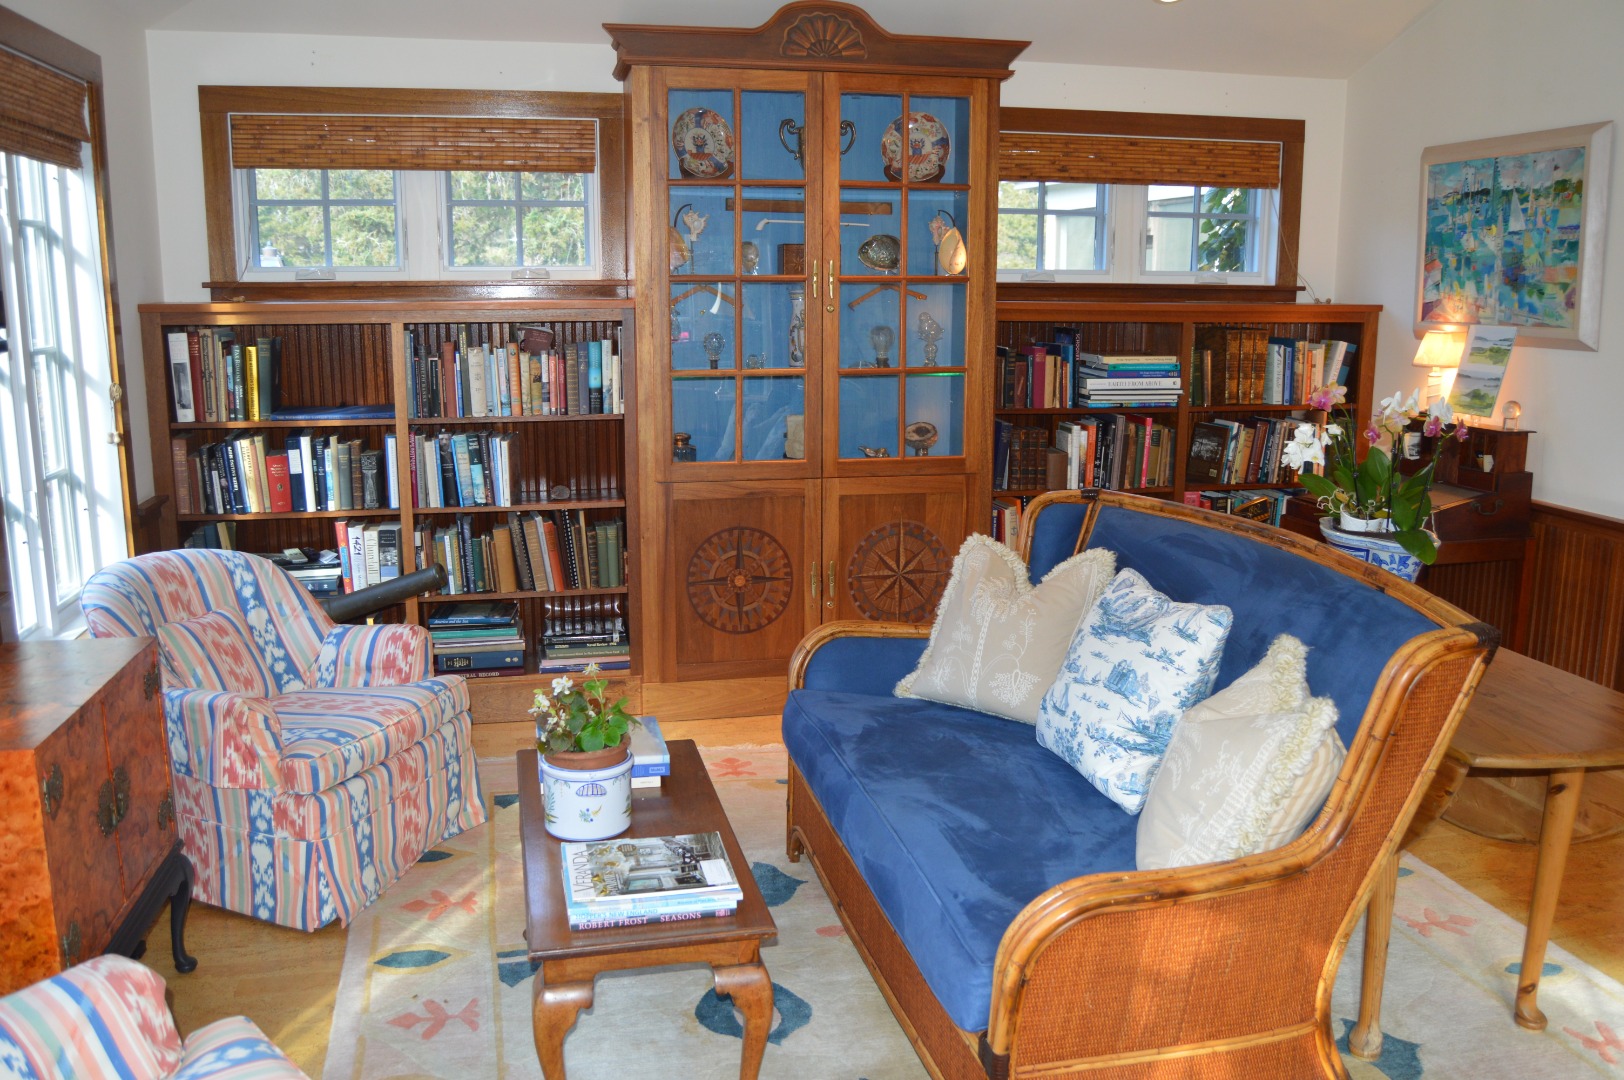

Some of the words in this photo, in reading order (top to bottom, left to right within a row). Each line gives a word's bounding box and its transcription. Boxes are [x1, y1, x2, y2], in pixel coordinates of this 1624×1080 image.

[352, 536, 362, 556] 1421
[573, 850, 594, 893] VERANDA
[579, 920, 615, 930] ROBERT
[619, 916, 648, 926] FROST
[660, 912, 702, 922] SEASONS
[609, 910, 624, 918] NEW
[626, 908, 659, 917] ENGLAND
